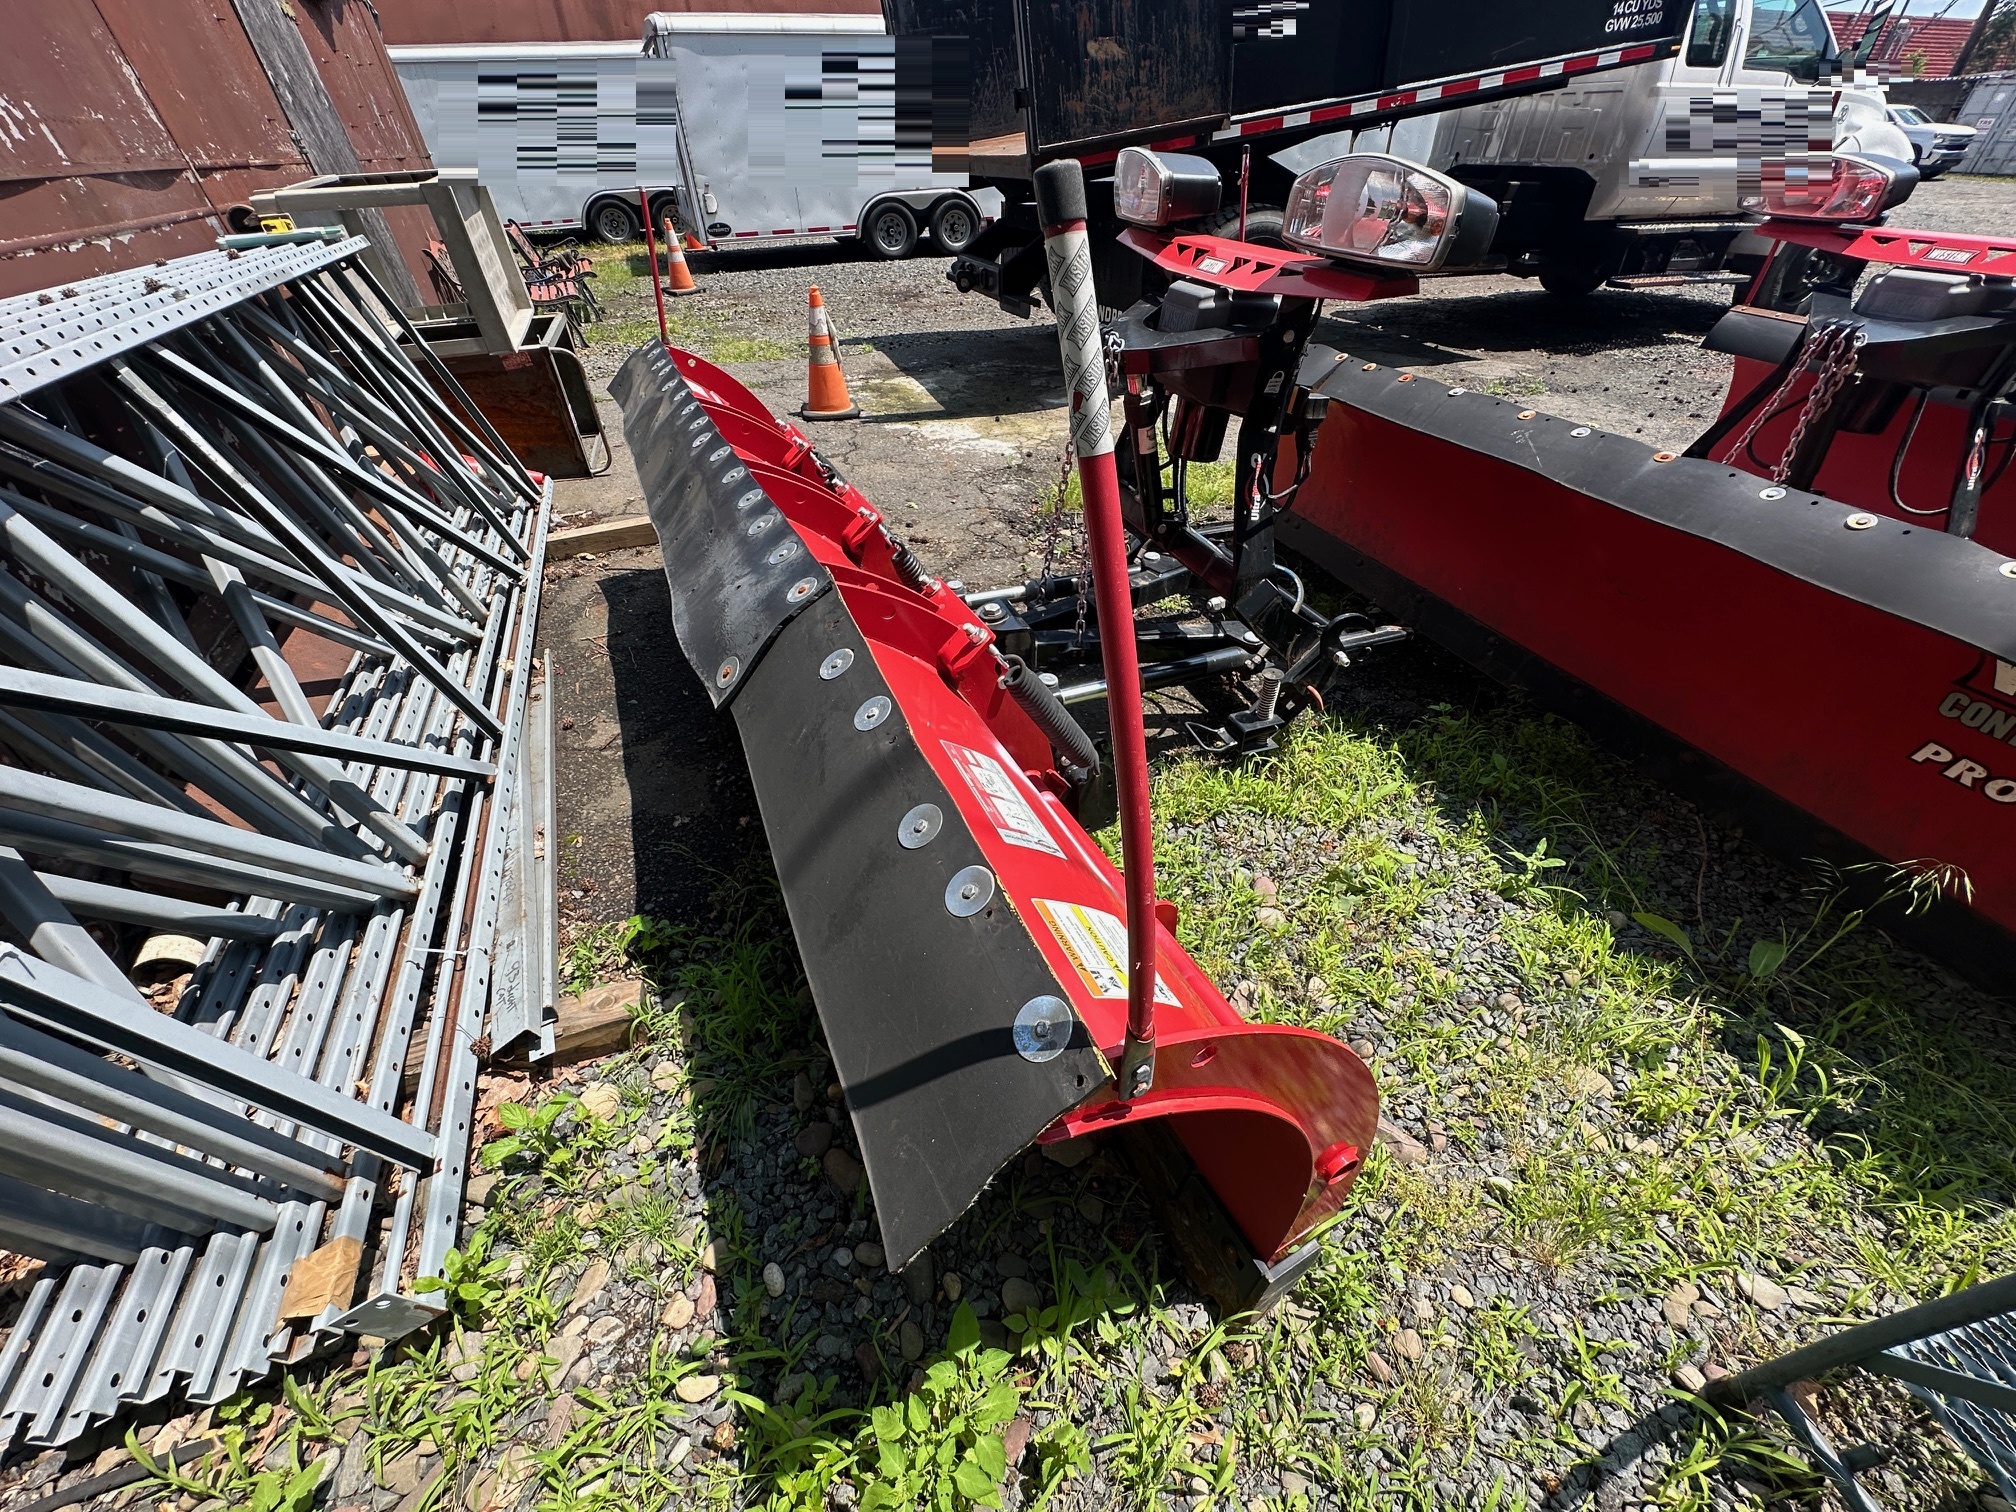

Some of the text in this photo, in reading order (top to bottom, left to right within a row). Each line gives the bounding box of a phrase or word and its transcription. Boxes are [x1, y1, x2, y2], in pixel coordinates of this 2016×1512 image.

[1605, 11, 1663, 32] GVW 25,500
[1613, 2, 1624, 15] 14
[1624, 0, 1640, 14] CU
[1926, 248, 1973, 263] WESTERN
[1938, 692, 2016, 746] CON
[1049, 920, 1079, 960] WARNING
[1086, 925, 1114, 962] CAUTION
